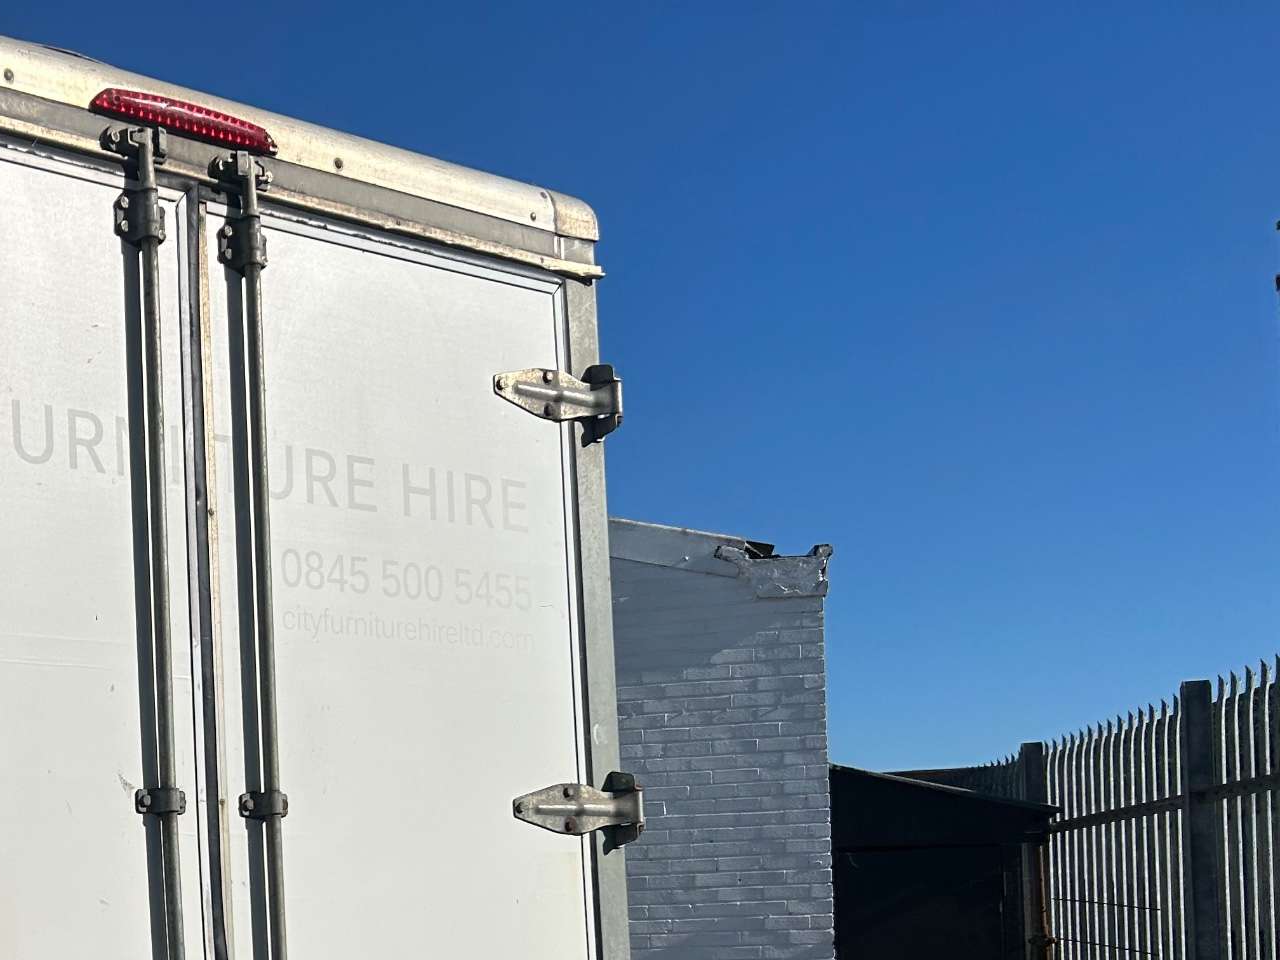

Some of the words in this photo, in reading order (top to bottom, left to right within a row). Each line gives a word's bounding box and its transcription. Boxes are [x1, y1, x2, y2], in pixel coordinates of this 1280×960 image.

[402, 463, 529, 534] HIRE
[281, 548, 370, 595] 0845
[381, 559, 443, 602] 500
[455, 568, 533, 612] 5455
